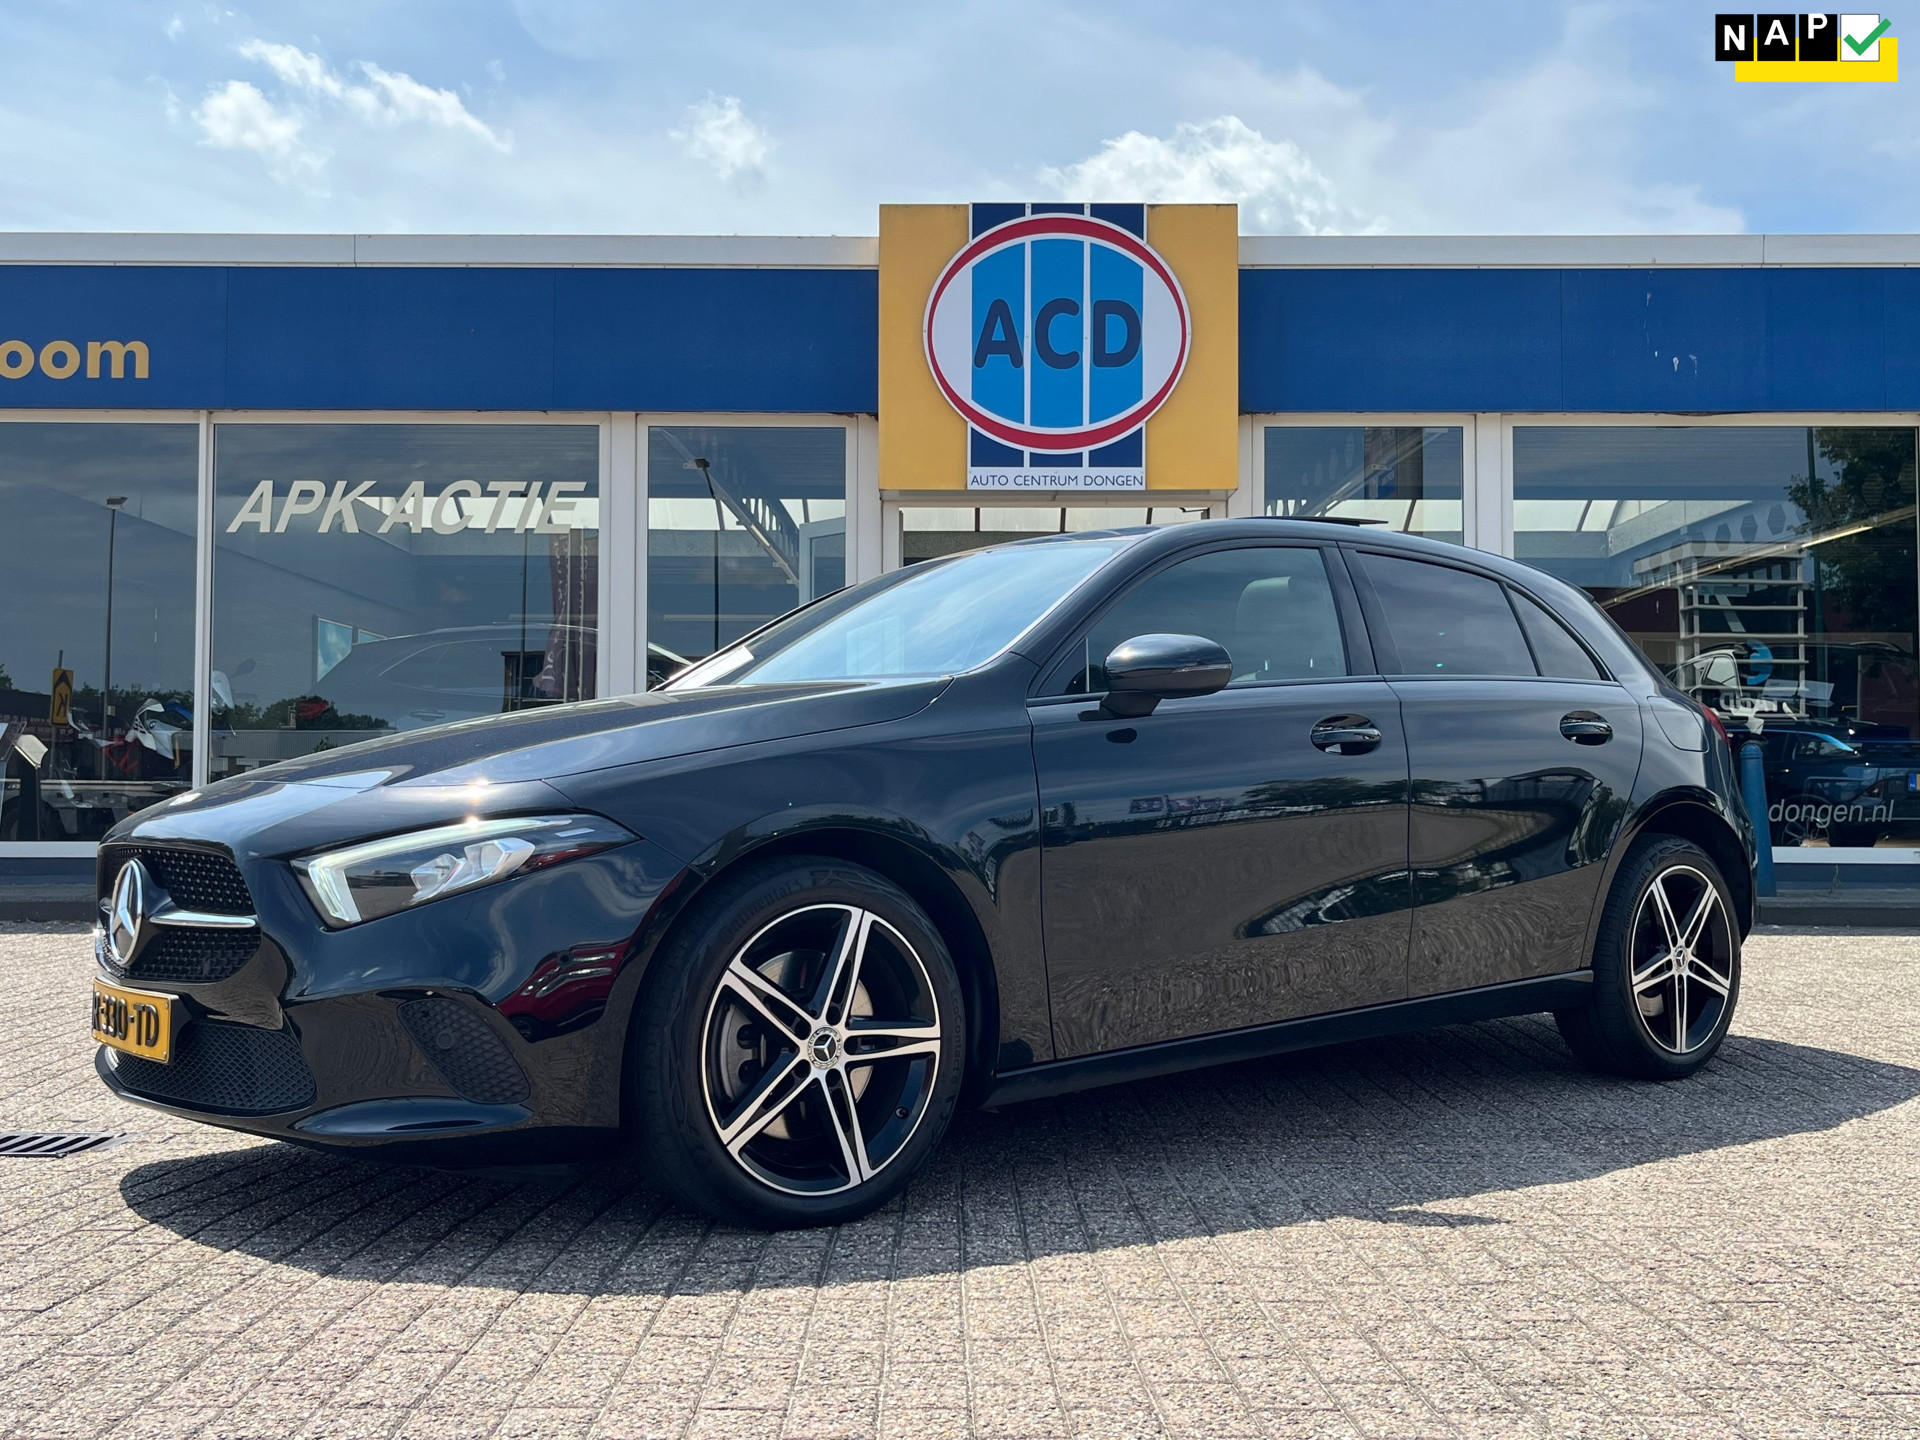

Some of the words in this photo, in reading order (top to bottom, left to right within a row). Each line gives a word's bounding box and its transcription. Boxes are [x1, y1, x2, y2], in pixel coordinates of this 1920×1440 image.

[974, 298, 1142, 370] ACD
[0, 340, 149, 379] oom
[970, 474, 1009, 486] AUTO
[1013, 474, 1078, 486] CENTRUM
[1083, 474, 1143, 486] DONGEN
[226, 480, 378, 534] APK
[377, 480, 588, 535] ACTIE
[1768, 799, 1895, 828] dongen.nl
